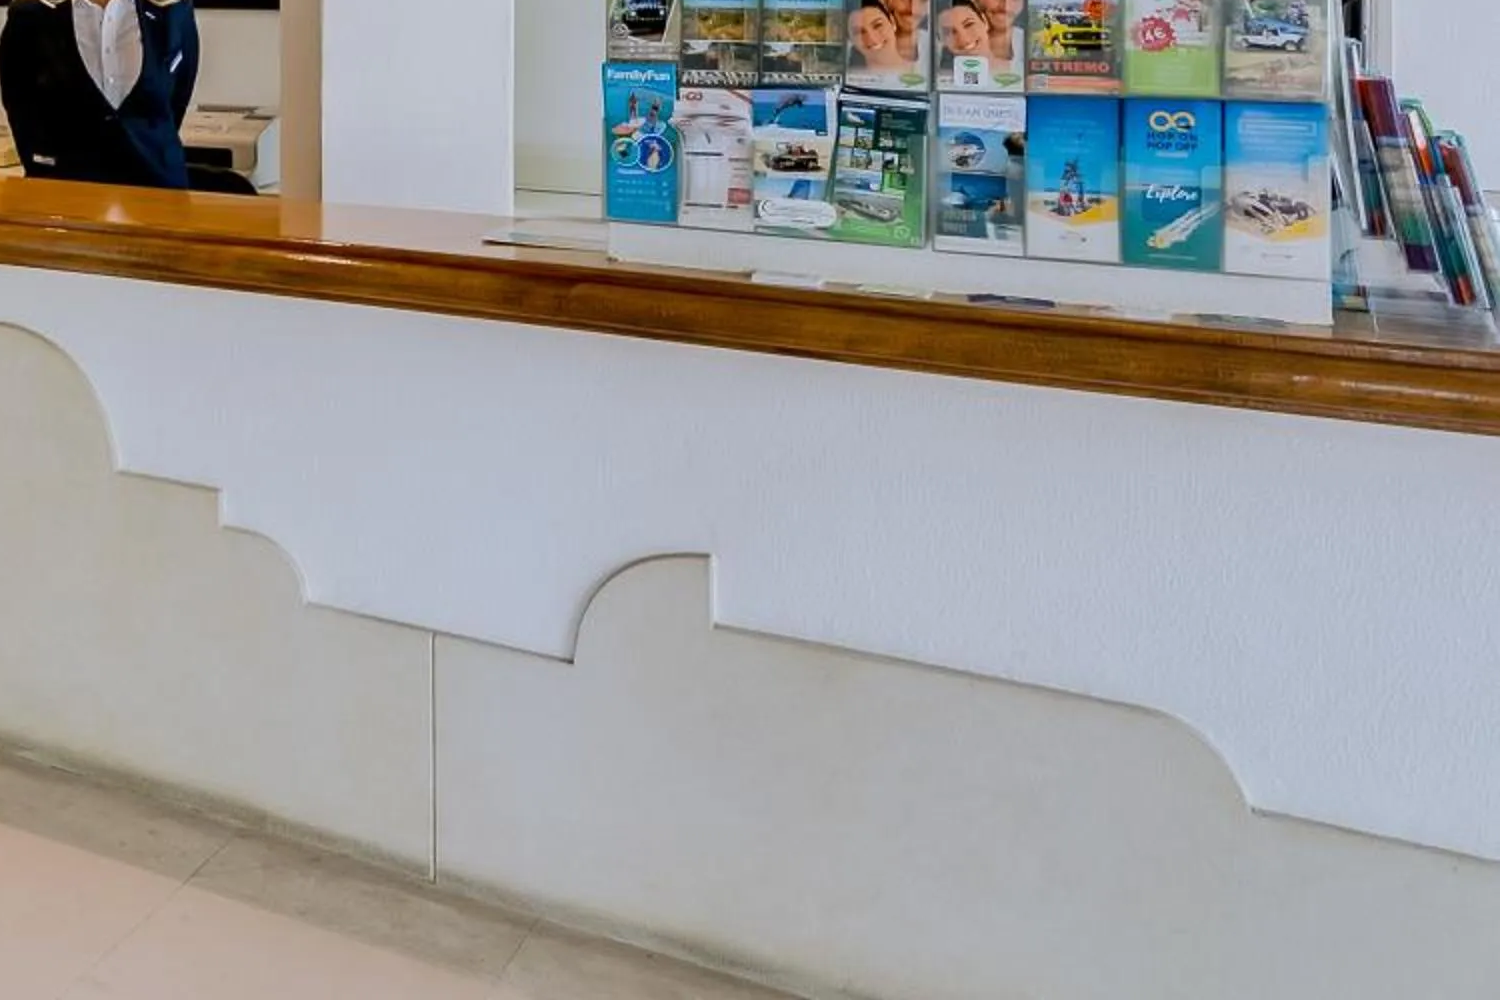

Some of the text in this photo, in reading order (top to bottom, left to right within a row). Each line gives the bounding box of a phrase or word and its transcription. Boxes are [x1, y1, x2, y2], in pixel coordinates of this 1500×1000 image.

[1030, 61, 1111, 74] EXTREMO
[607, 68, 670, 82] FamilyFun
[1146, 184, 1198, 204] Explore
